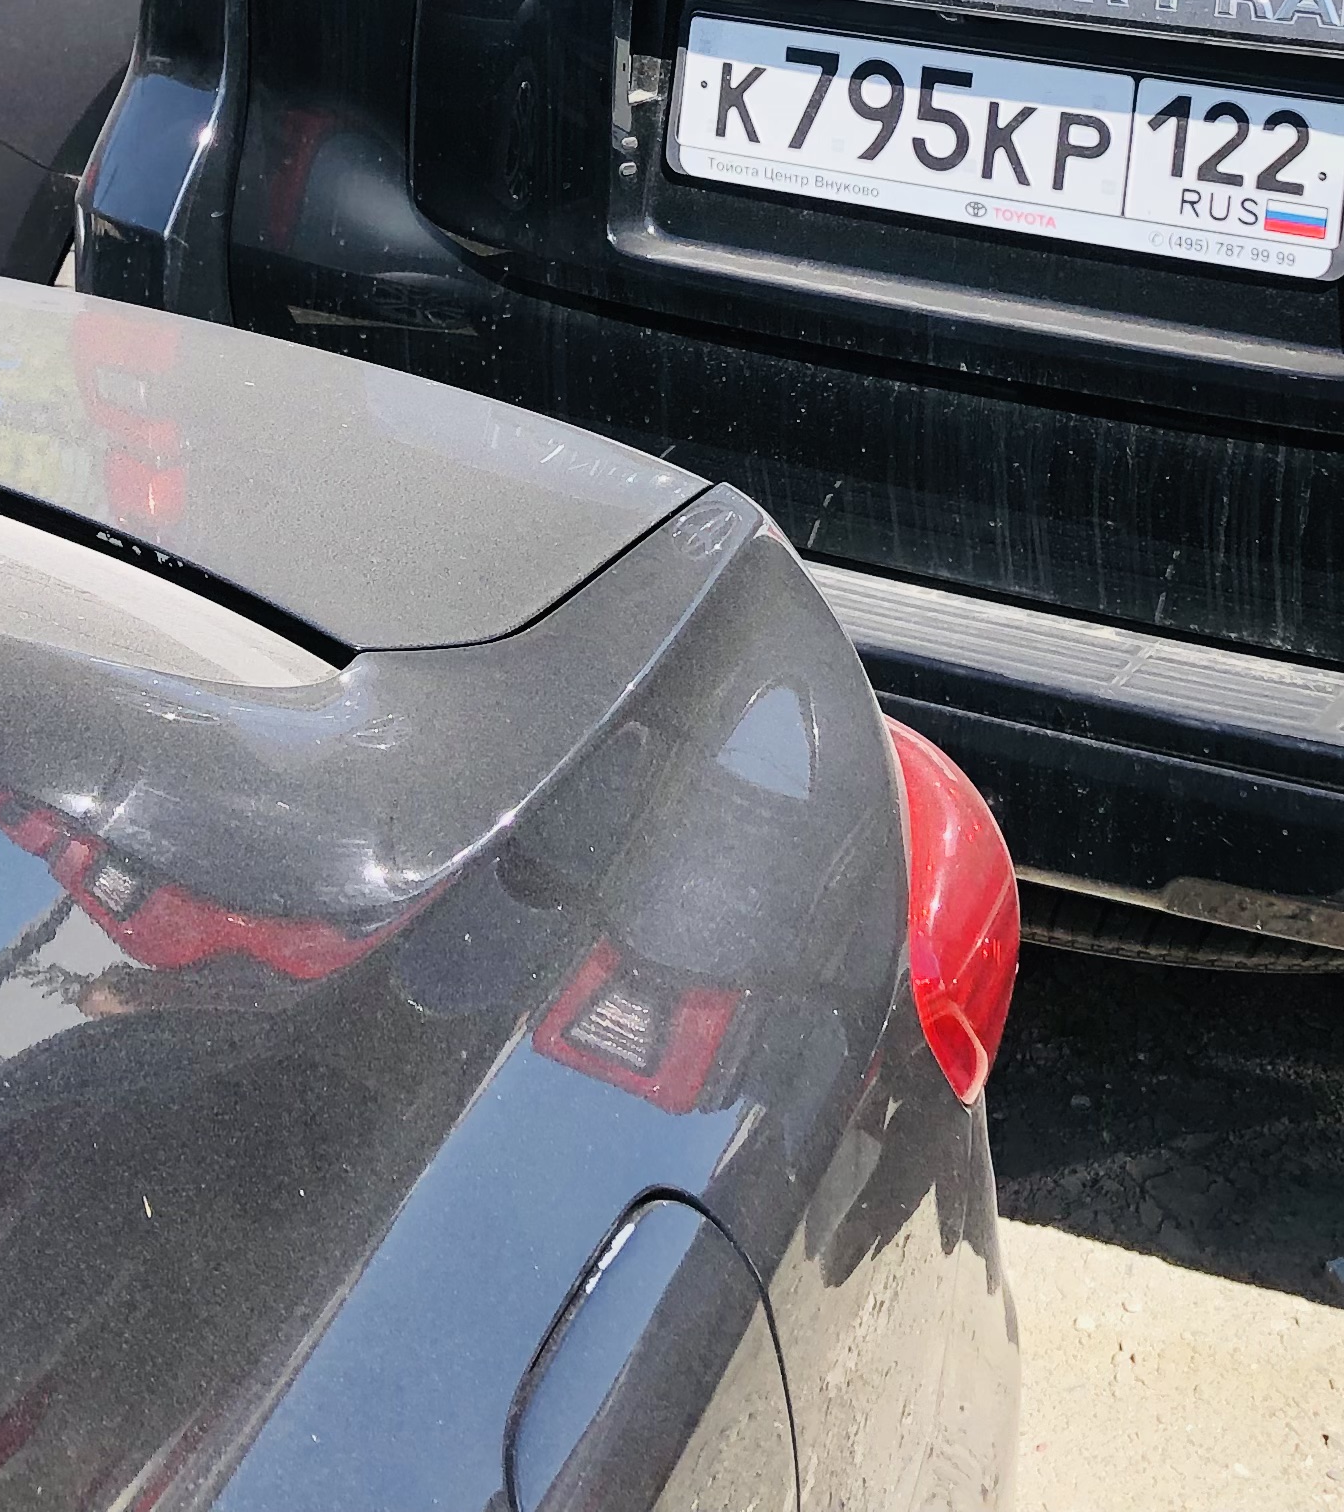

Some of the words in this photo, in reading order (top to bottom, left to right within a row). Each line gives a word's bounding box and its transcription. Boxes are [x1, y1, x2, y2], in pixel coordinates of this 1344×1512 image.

[1147, 95, 1310, 196] 122
[764, 167, 810, 187] Центр
[814, 175, 880, 199] Внуково
[993, 207, 1057, 230] TOYOTA
[1179, 188, 1259, 226] RUS
[1168, 232, 1209, 255] (495)
[1215, 241, 1245, 258] 787
[1250, 247, 1270, 263] 99
[1276, 251, 1296, 267] 99
